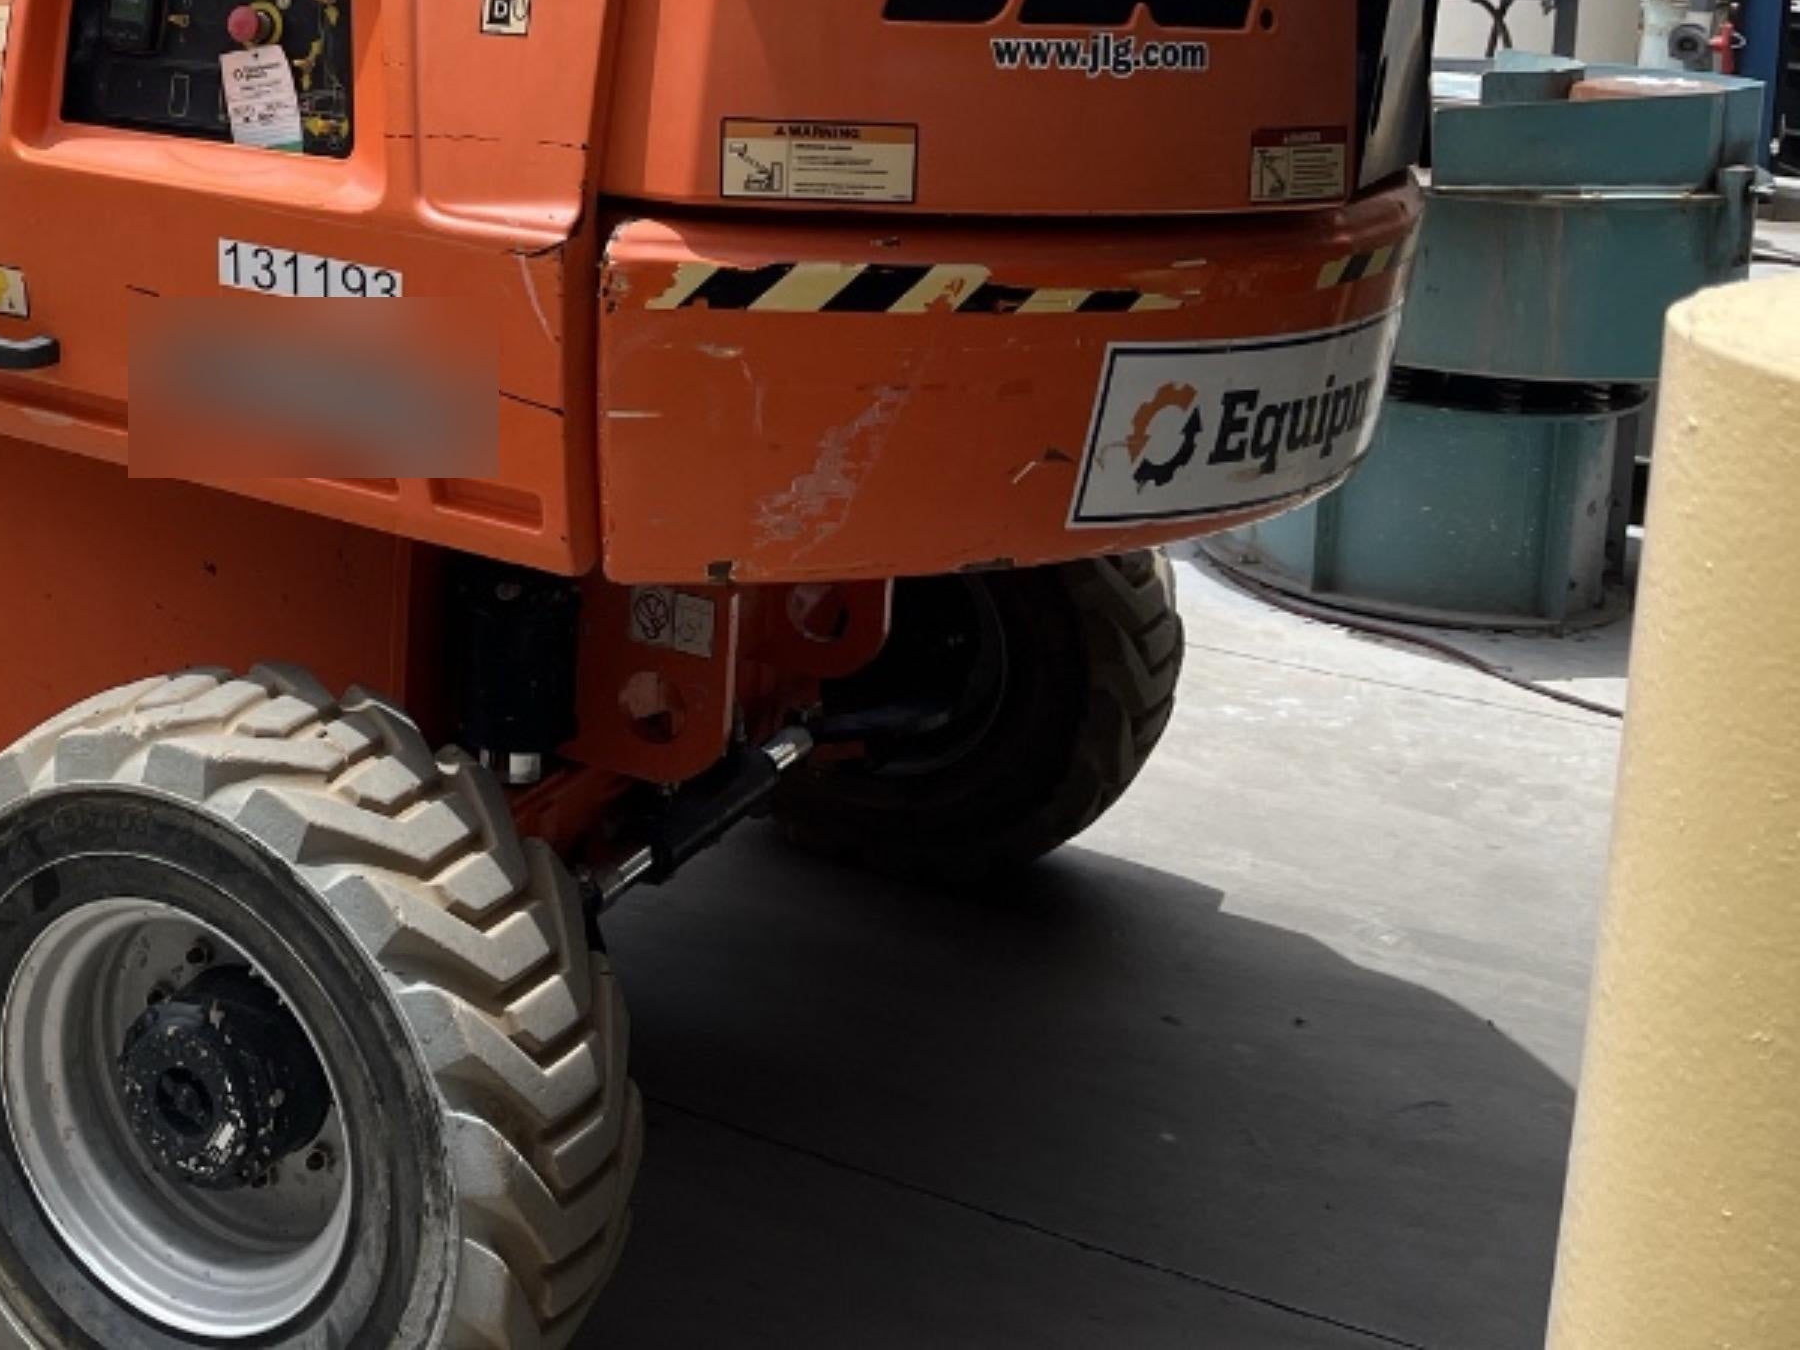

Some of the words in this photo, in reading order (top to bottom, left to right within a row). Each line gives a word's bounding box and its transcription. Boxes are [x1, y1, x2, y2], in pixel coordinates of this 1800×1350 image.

[991, 33, 1208, 78] www.jlg.com
[789, 125, 861, 140] WARNING
[223, 241, 398, 298] 131193
